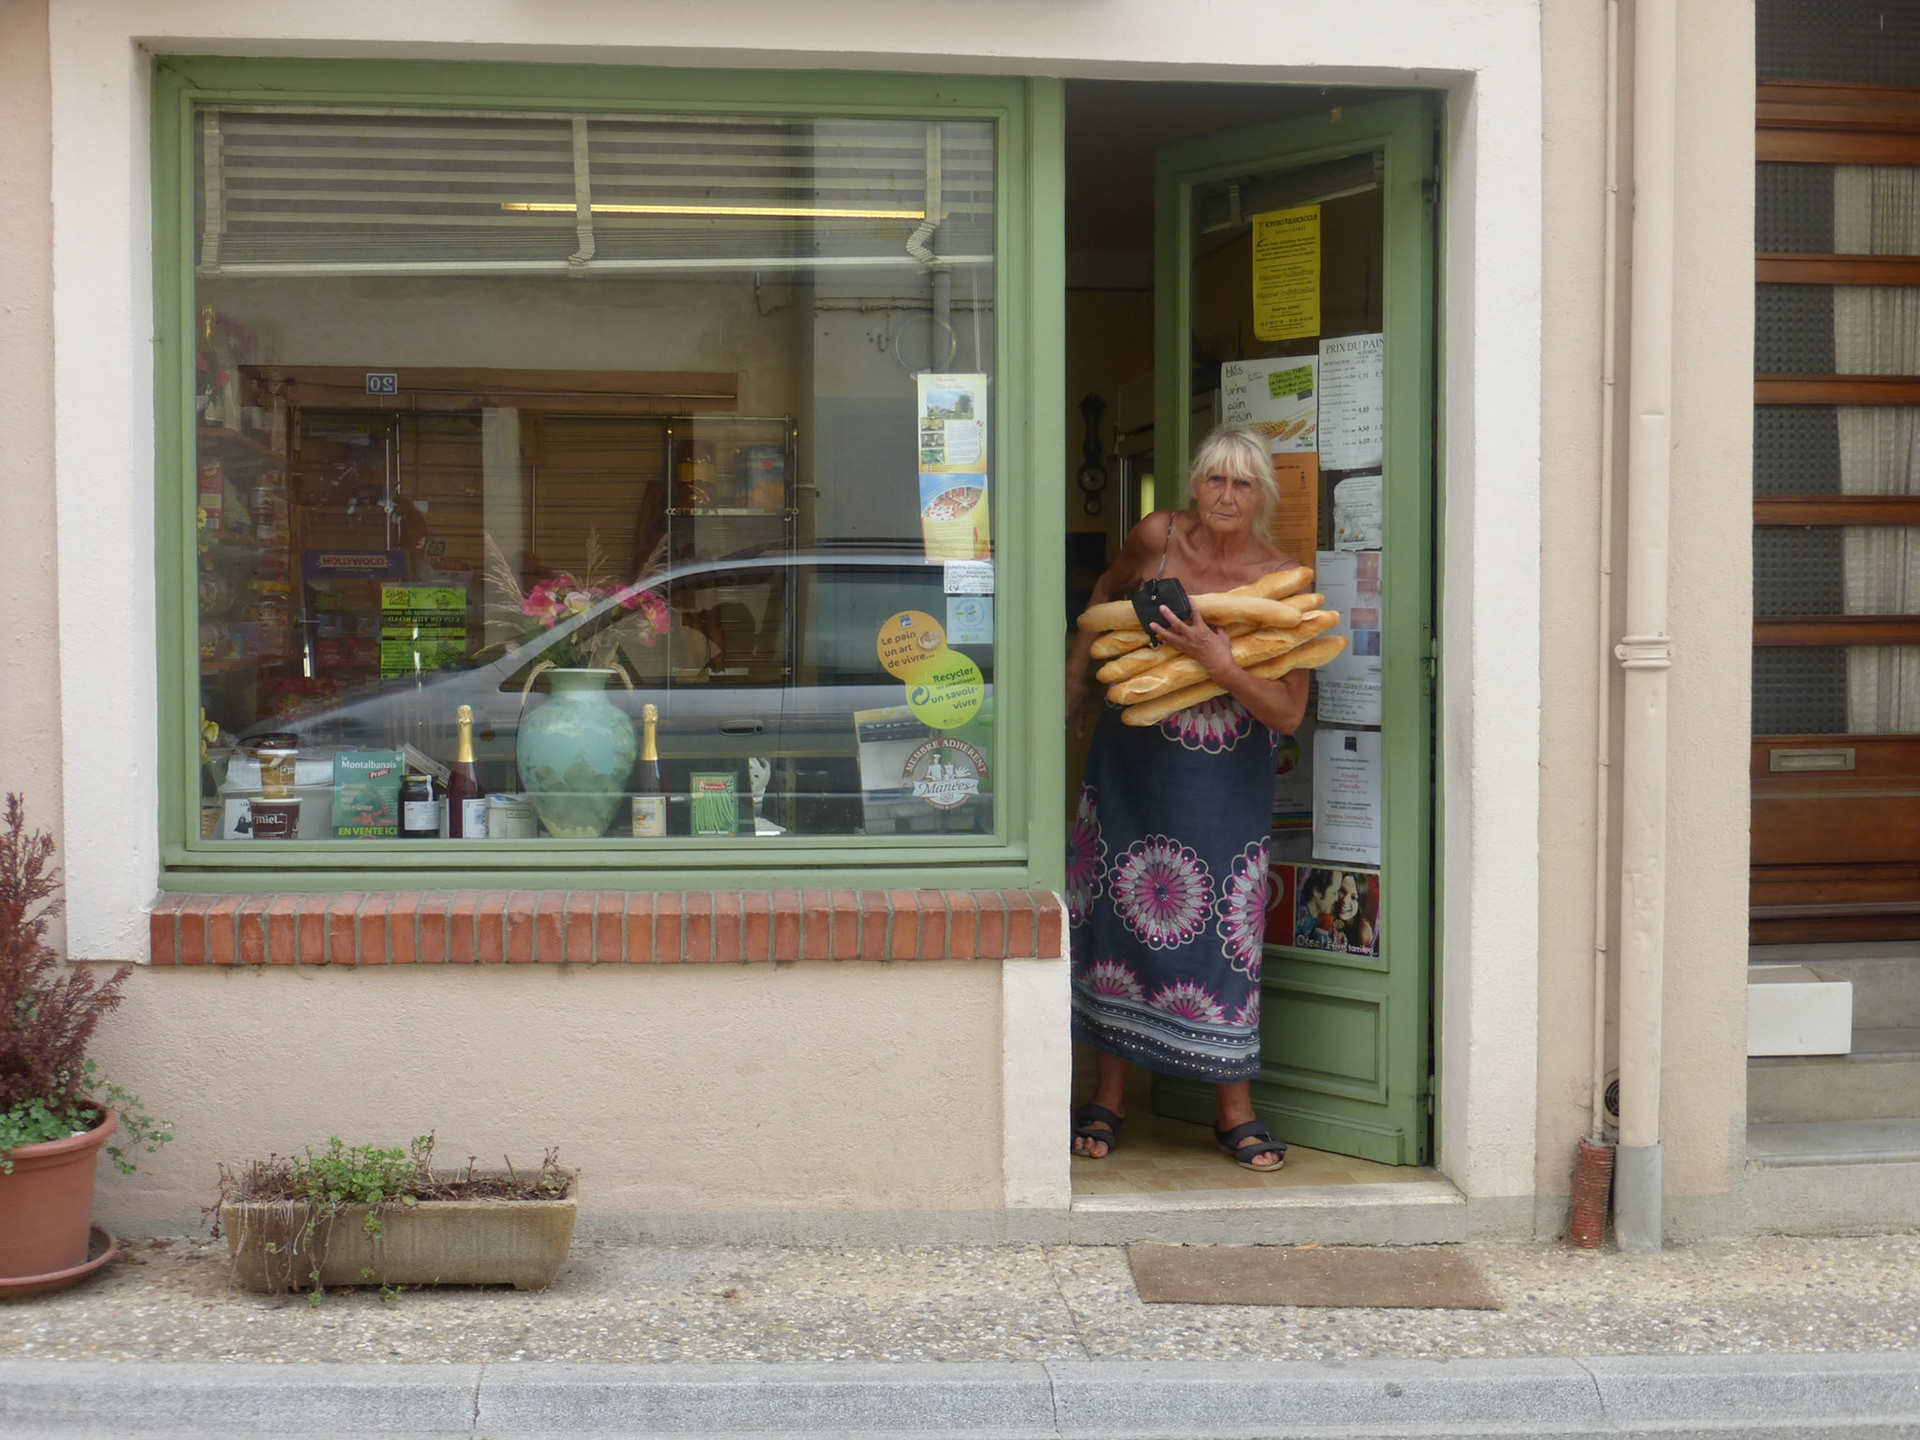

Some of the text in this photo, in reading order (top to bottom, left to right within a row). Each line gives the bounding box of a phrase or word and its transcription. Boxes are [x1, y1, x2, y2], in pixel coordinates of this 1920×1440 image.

[1325, 343, 1345, 354] PRIX
[1347, 341, 1361, 351] DU
[1225, 364, 1243, 378] blés
[1227, 398, 1245, 412] pain
[322, 556, 384, 565] HOLLYWOOD
[881, 631, 917, 646] Le pain
[884, 643, 913, 657] un art
[887, 658, 900, 669] de
[933, 667, 974, 683] Recycler
[931, 687, 978, 704] un savoir-
[953, 698, 977, 710] vivre
[906, 740, 940, 773] MEMBRE
[341, 760, 397, 769] Montalbanais
[370, 768, 389, 779] Pratic
[338, 827, 397, 836] EN VENTE ICI
